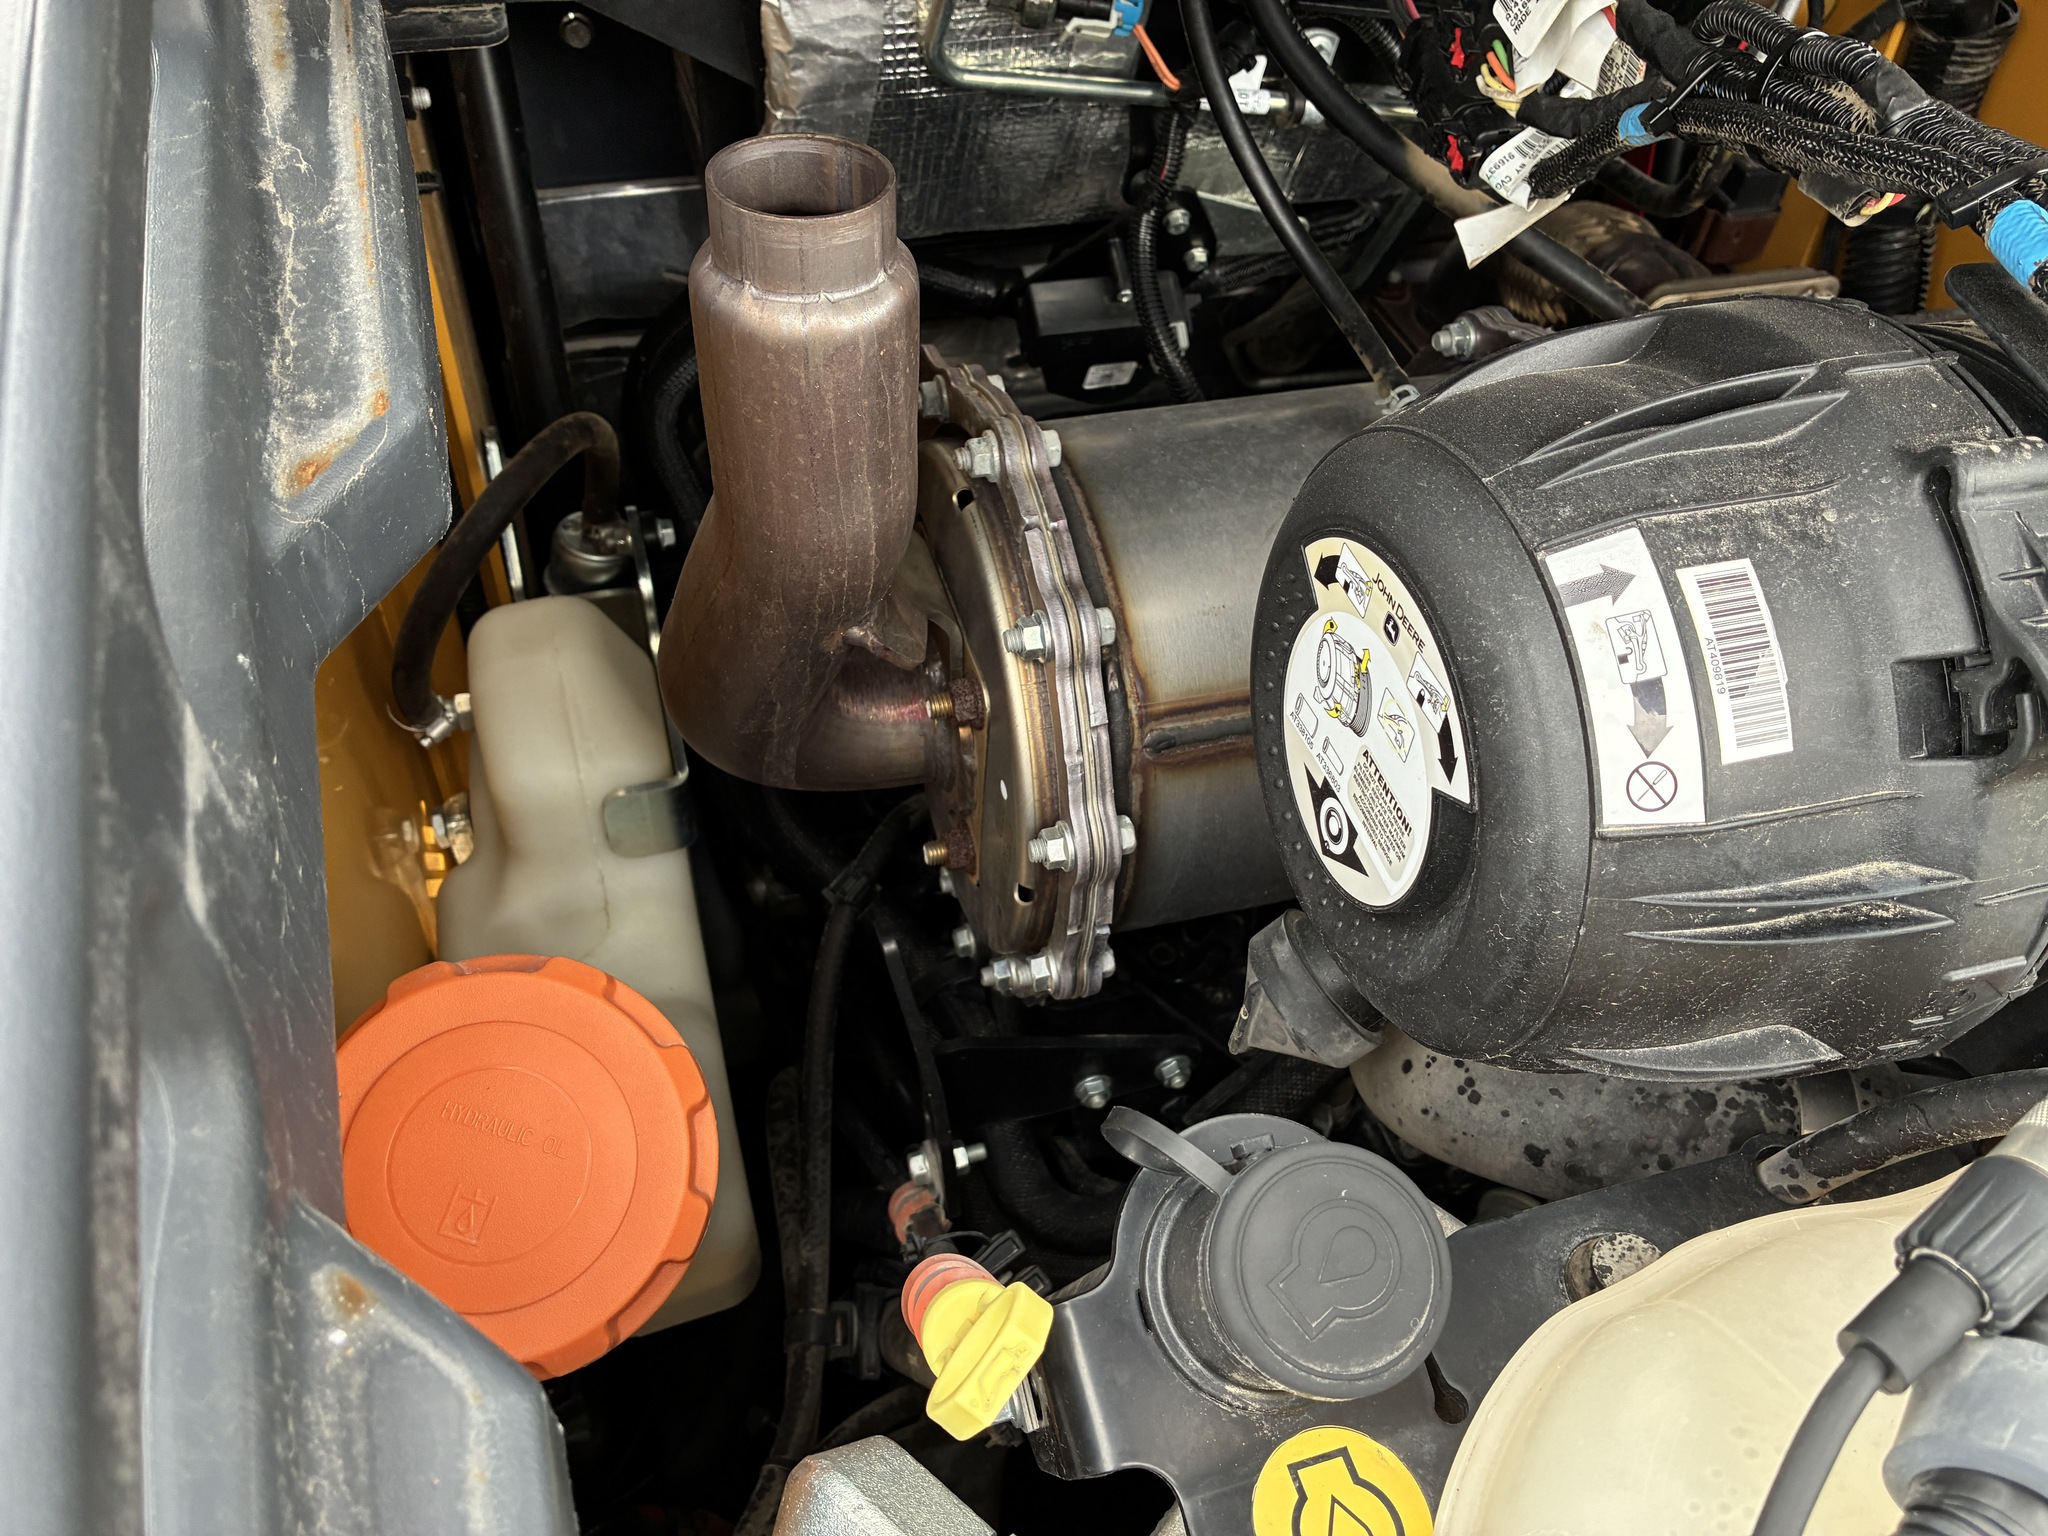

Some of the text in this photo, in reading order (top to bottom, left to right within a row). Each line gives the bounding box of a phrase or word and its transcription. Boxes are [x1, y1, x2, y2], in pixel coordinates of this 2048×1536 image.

[1505, 0, 1522, 21] AT4
[1513, 6, 1532, 35] MADE
[1616, 73, 1623, 85] IN
[1372, 573, 1426, 653] JOHN DEERE
[1704, 637, 1726, 695] AT409819
[1352, 773, 1374, 813] RESTRICTION
[1377, 819, 1395, 851] INDICATED
[1353, 765, 1405, 858] ELEMENT ONLY AFTER MAXIMUM
[1362, 749, 1412, 837] ATTENTION!
[1371, 786, 1387, 815] REPLACE
[1393, 828, 1406, 849] FILTER
[1375, 784, 1387, 805] CLEAN
[1352, 793, 1392, 865] RECOMMENDED SERVICE
[1358, 794, 1378, 830] ACCORDING
[1382, 838, 1390, 852] THE
[441, 1101, 566, 1159] HYDRAULIC OIL
